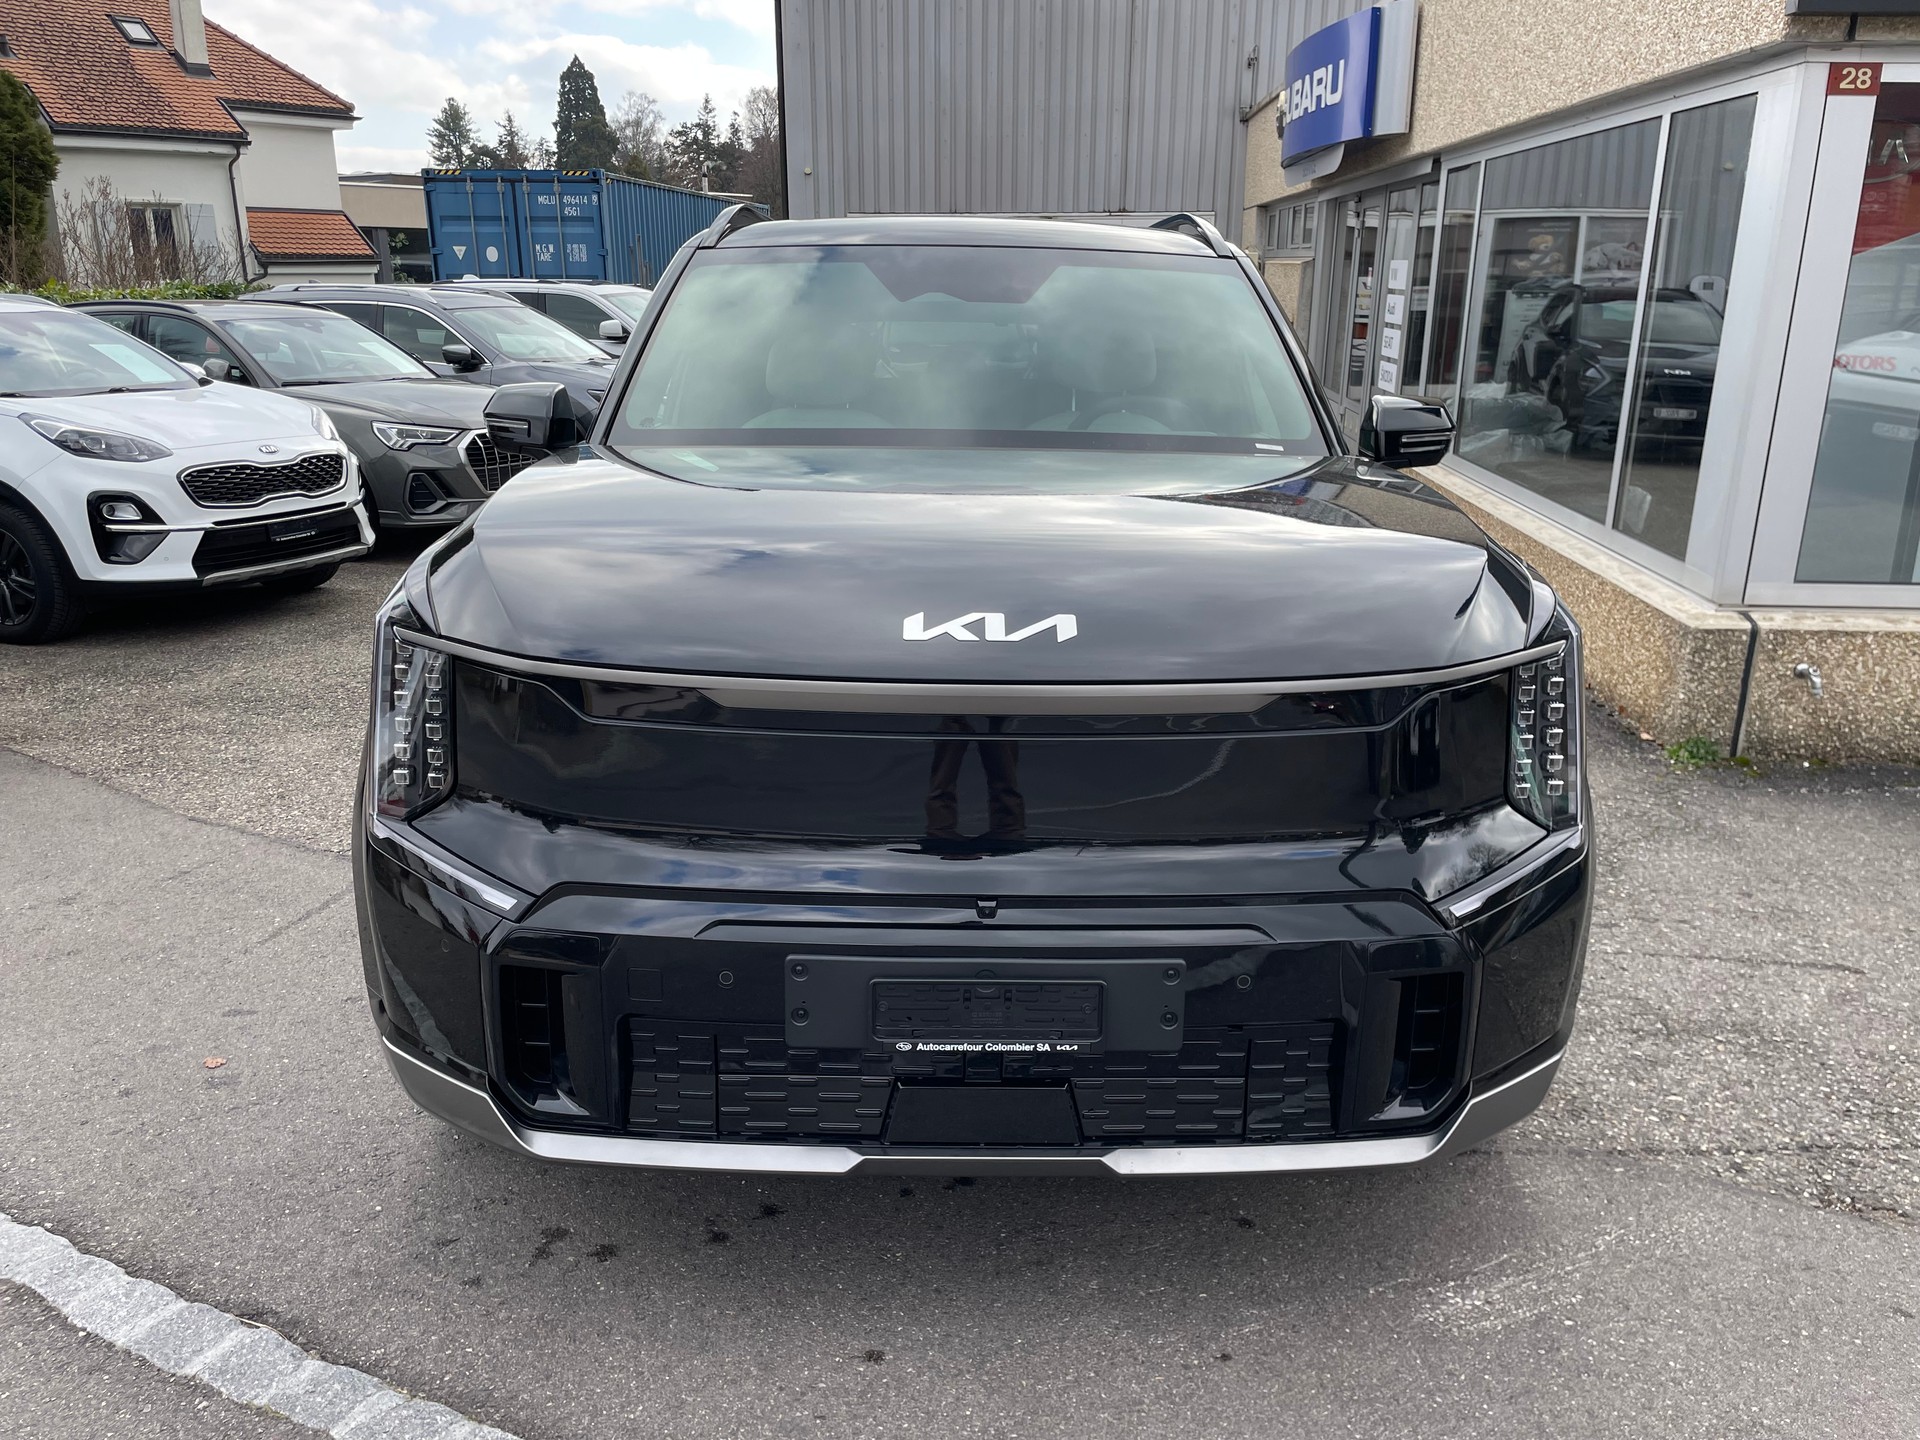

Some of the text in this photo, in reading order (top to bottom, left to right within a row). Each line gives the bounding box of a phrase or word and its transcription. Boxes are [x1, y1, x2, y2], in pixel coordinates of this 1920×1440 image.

[1839, 67, 1872, 89] 28
[1283, 59, 1345, 127] UBARU
[537, 195, 556, 205] MGLU
[562, 195, 588, 205] 496414
[564, 207, 580, 216] 45G1
[536, 252, 553, 262] TARE
[903, 612, 1078, 643] KIA
[916, 1042, 983, 1051] Autocarrefour
[985, 1043, 1034, 1051] Colombier
[1036, 1043, 1051, 1051] SA
